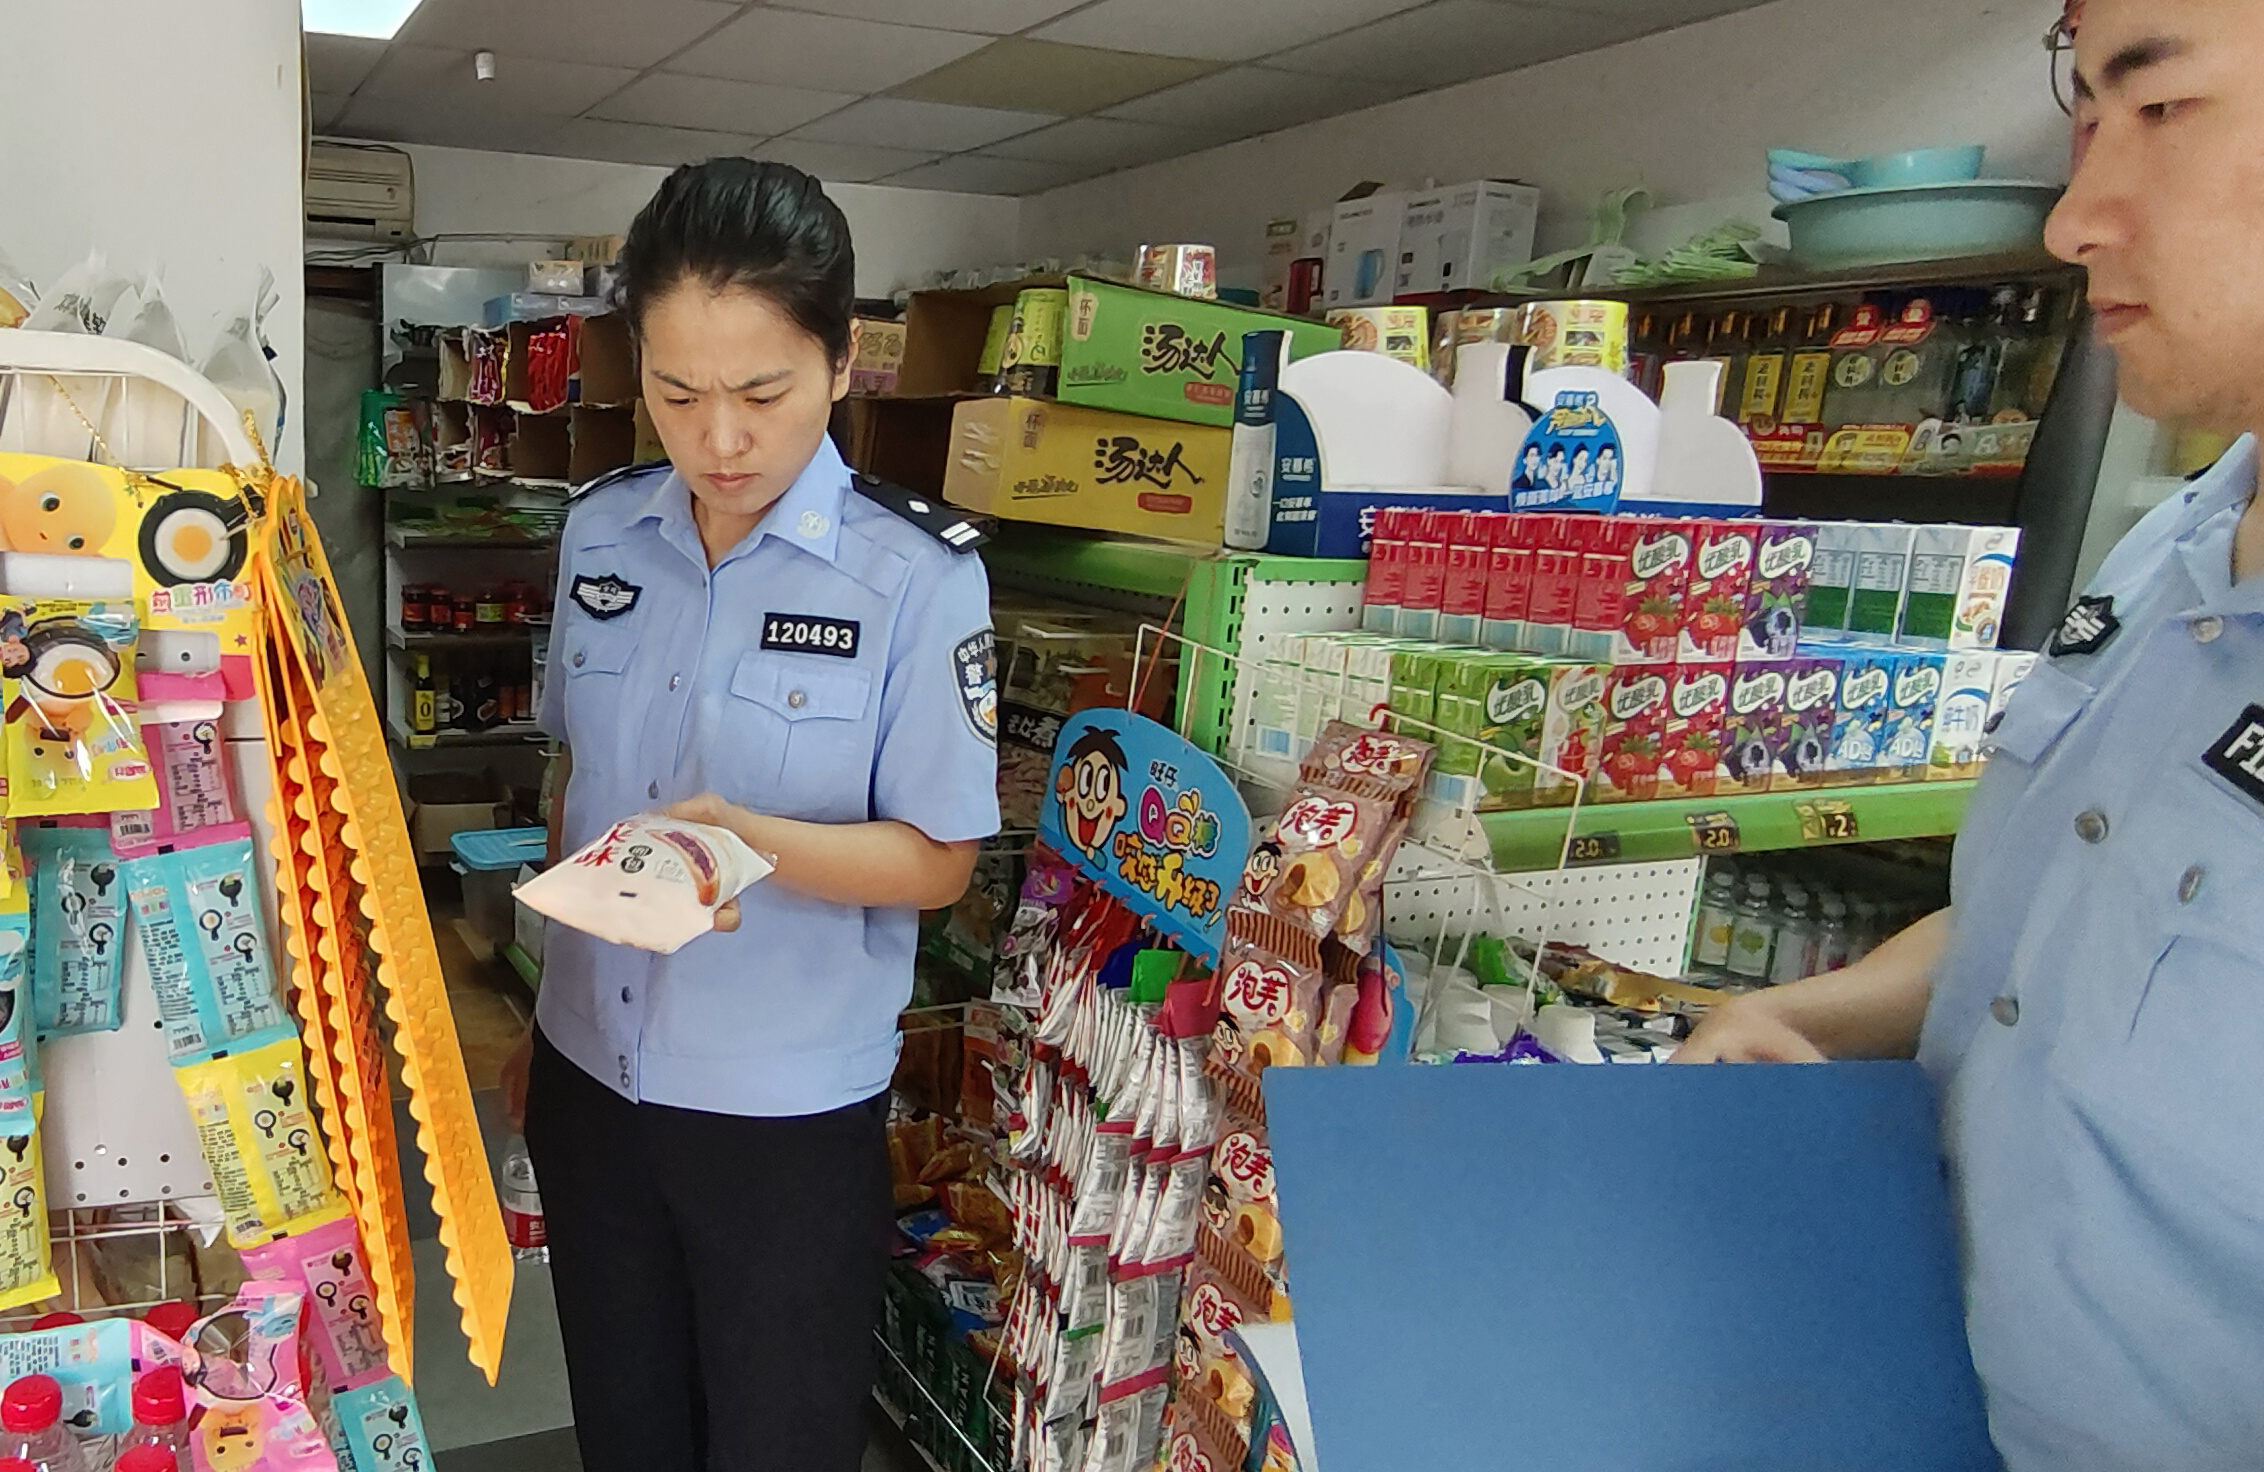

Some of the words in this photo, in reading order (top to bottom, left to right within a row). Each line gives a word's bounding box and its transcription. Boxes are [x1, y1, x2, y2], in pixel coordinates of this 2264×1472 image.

[1142, 324, 1240, 380] 汤达人
[1095, 436, 1205, 489] 汤达人
[767, 620, 853, 650] 120493
[1150, 760, 1179, 788] 旺仔
[1281, 801, 1353, 841] 泡芙
[1227, 967, 1288, 1026] 泡芙
[1221, 1136, 1273, 1194] 泡芙
